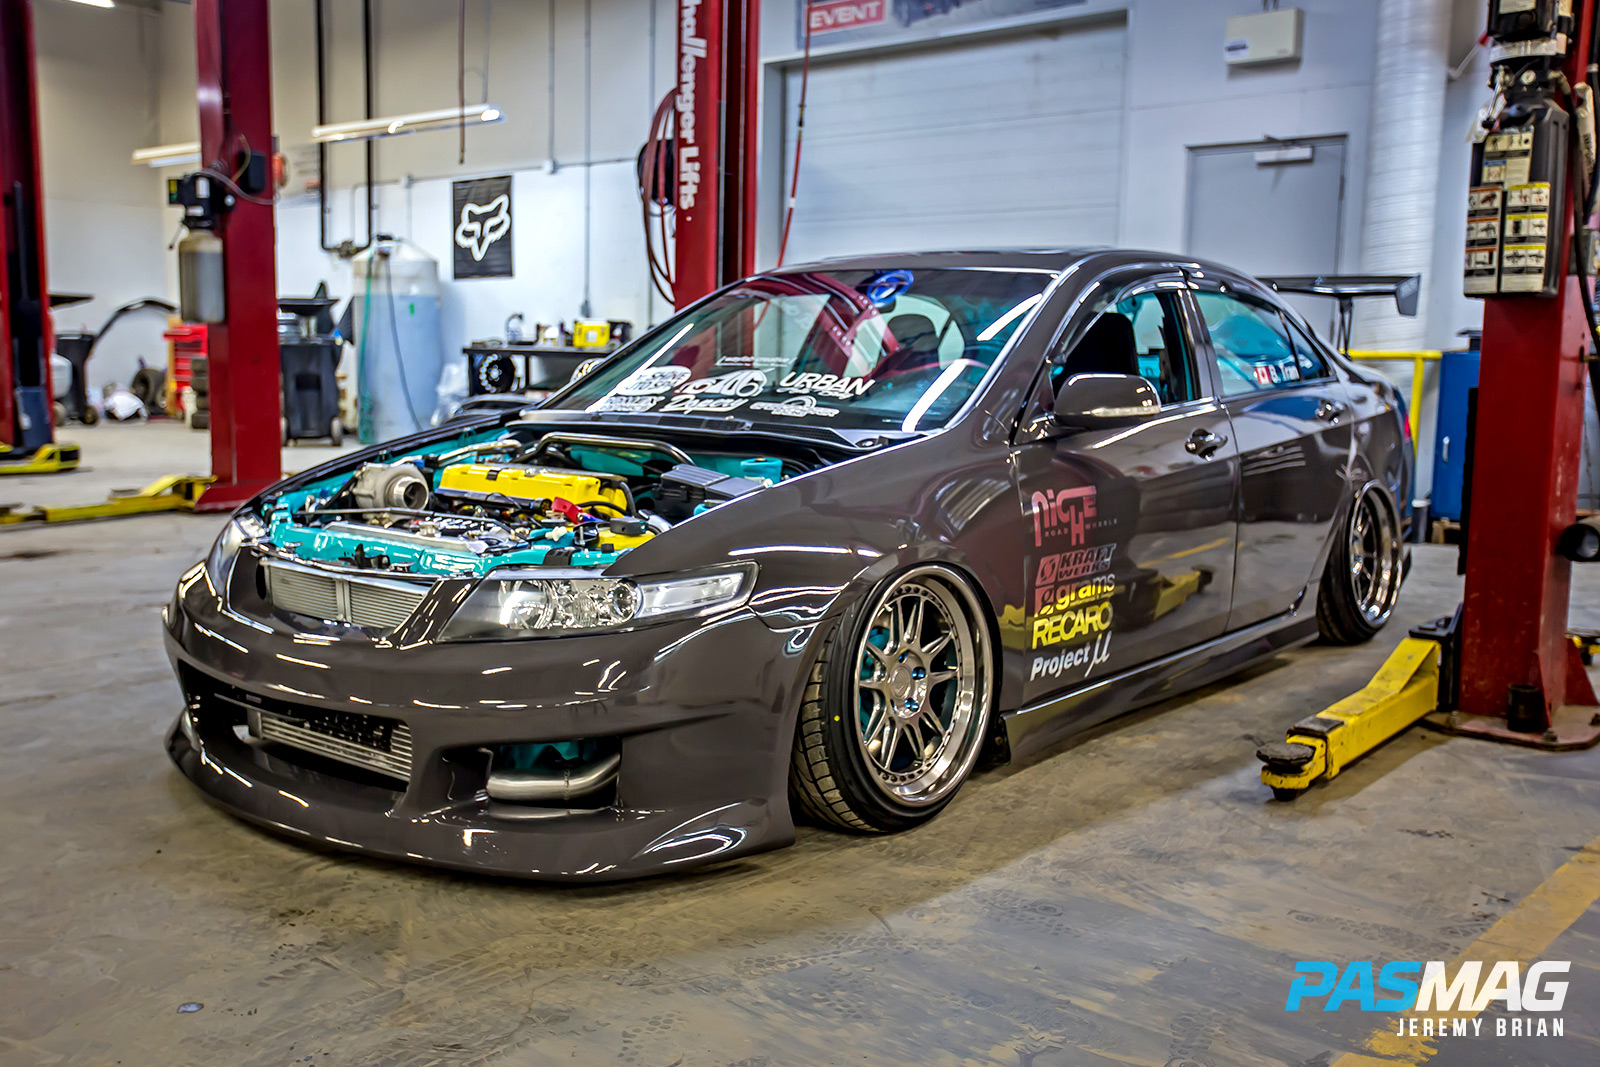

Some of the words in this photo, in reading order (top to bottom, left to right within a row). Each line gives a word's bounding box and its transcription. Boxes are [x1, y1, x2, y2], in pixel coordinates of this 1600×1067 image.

[809, 1, 881, 28] EVENT
[675, 0, 707, 144] hallenger
[679, 146, 701, 210] Lifts
[779, 371, 875, 396] URBAN
[1060, 544, 1116, 569] KRAFT
[1055, 573, 1116, 611] grams
[1031, 601, 1114, 650] RECARO
[1029, 642, 1091, 682] Project
